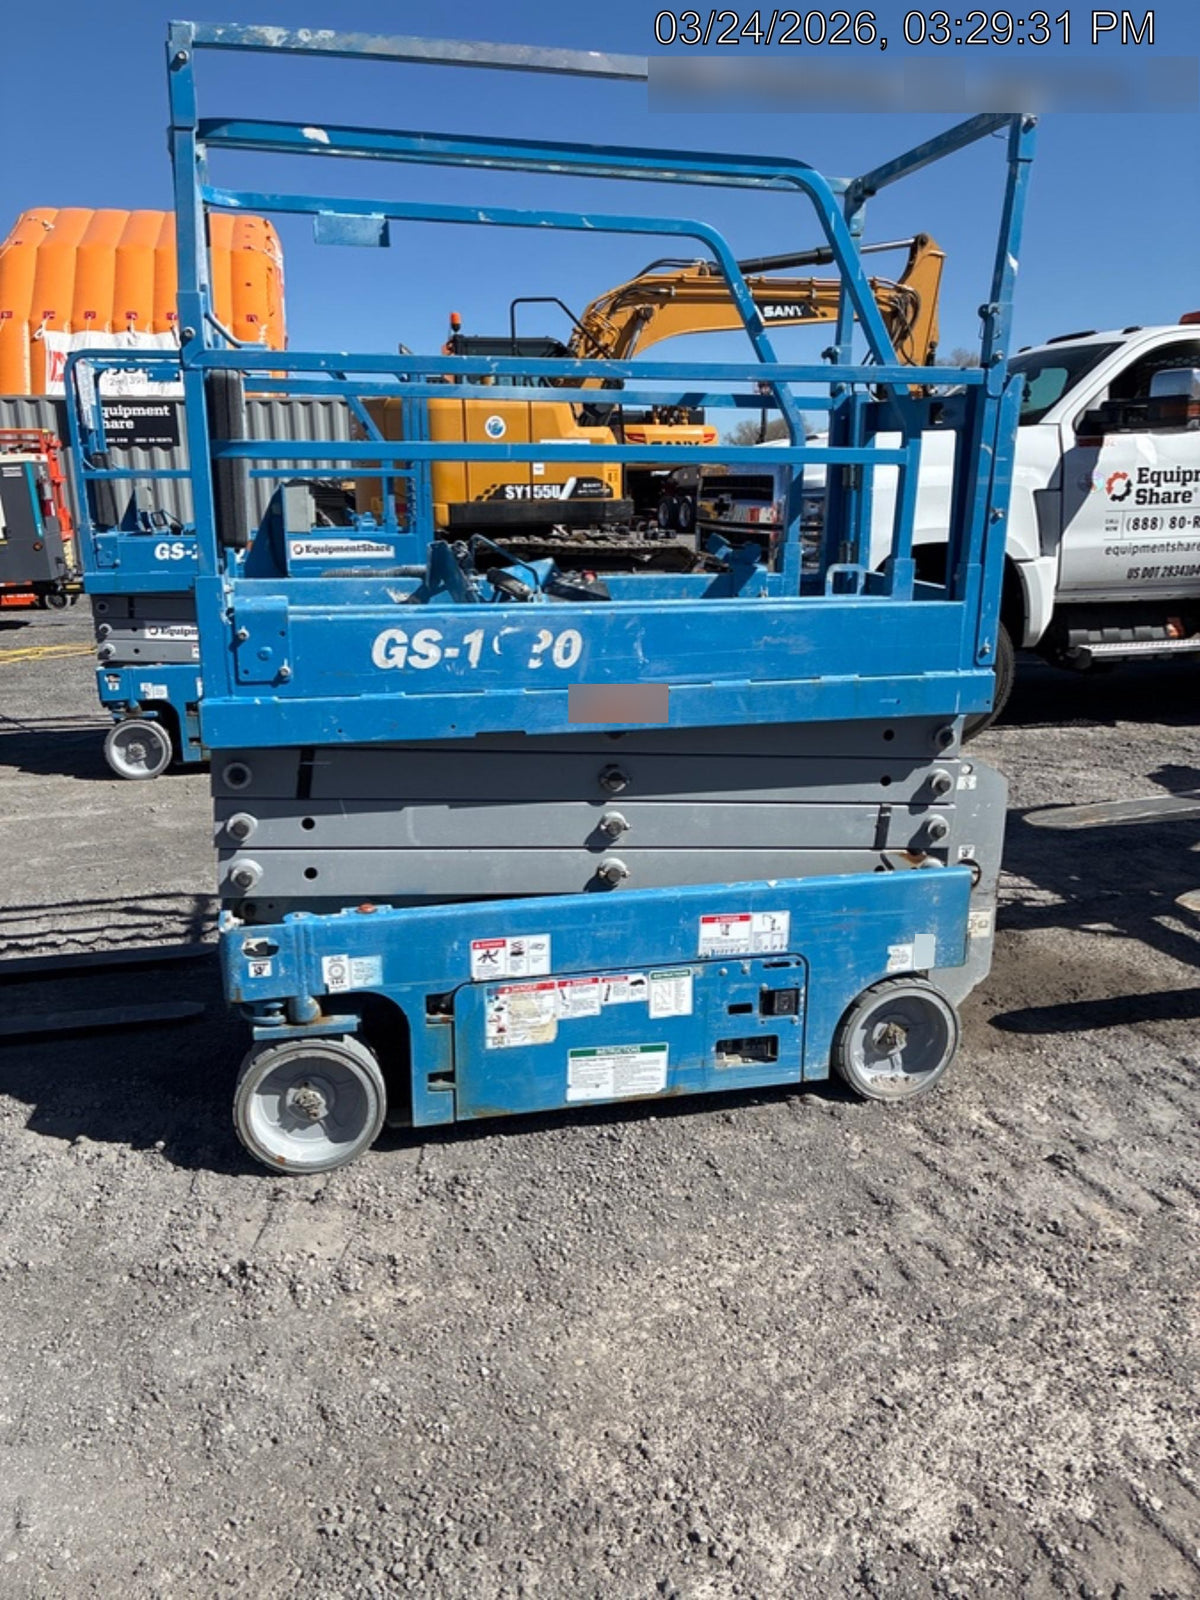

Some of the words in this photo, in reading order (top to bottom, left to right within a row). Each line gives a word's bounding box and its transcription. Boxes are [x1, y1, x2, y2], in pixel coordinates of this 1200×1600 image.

[763, 304, 804, 318] SANY
[101, 404, 171, 419] quipment
[103, 419, 134, 430] hare
[504, 484, 561, 500] SY155U
[1135, 488, 1193, 505] Share
[1126, 516, 1165, 532] (888)
[305, 543, 392, 555] EquipmentShare
